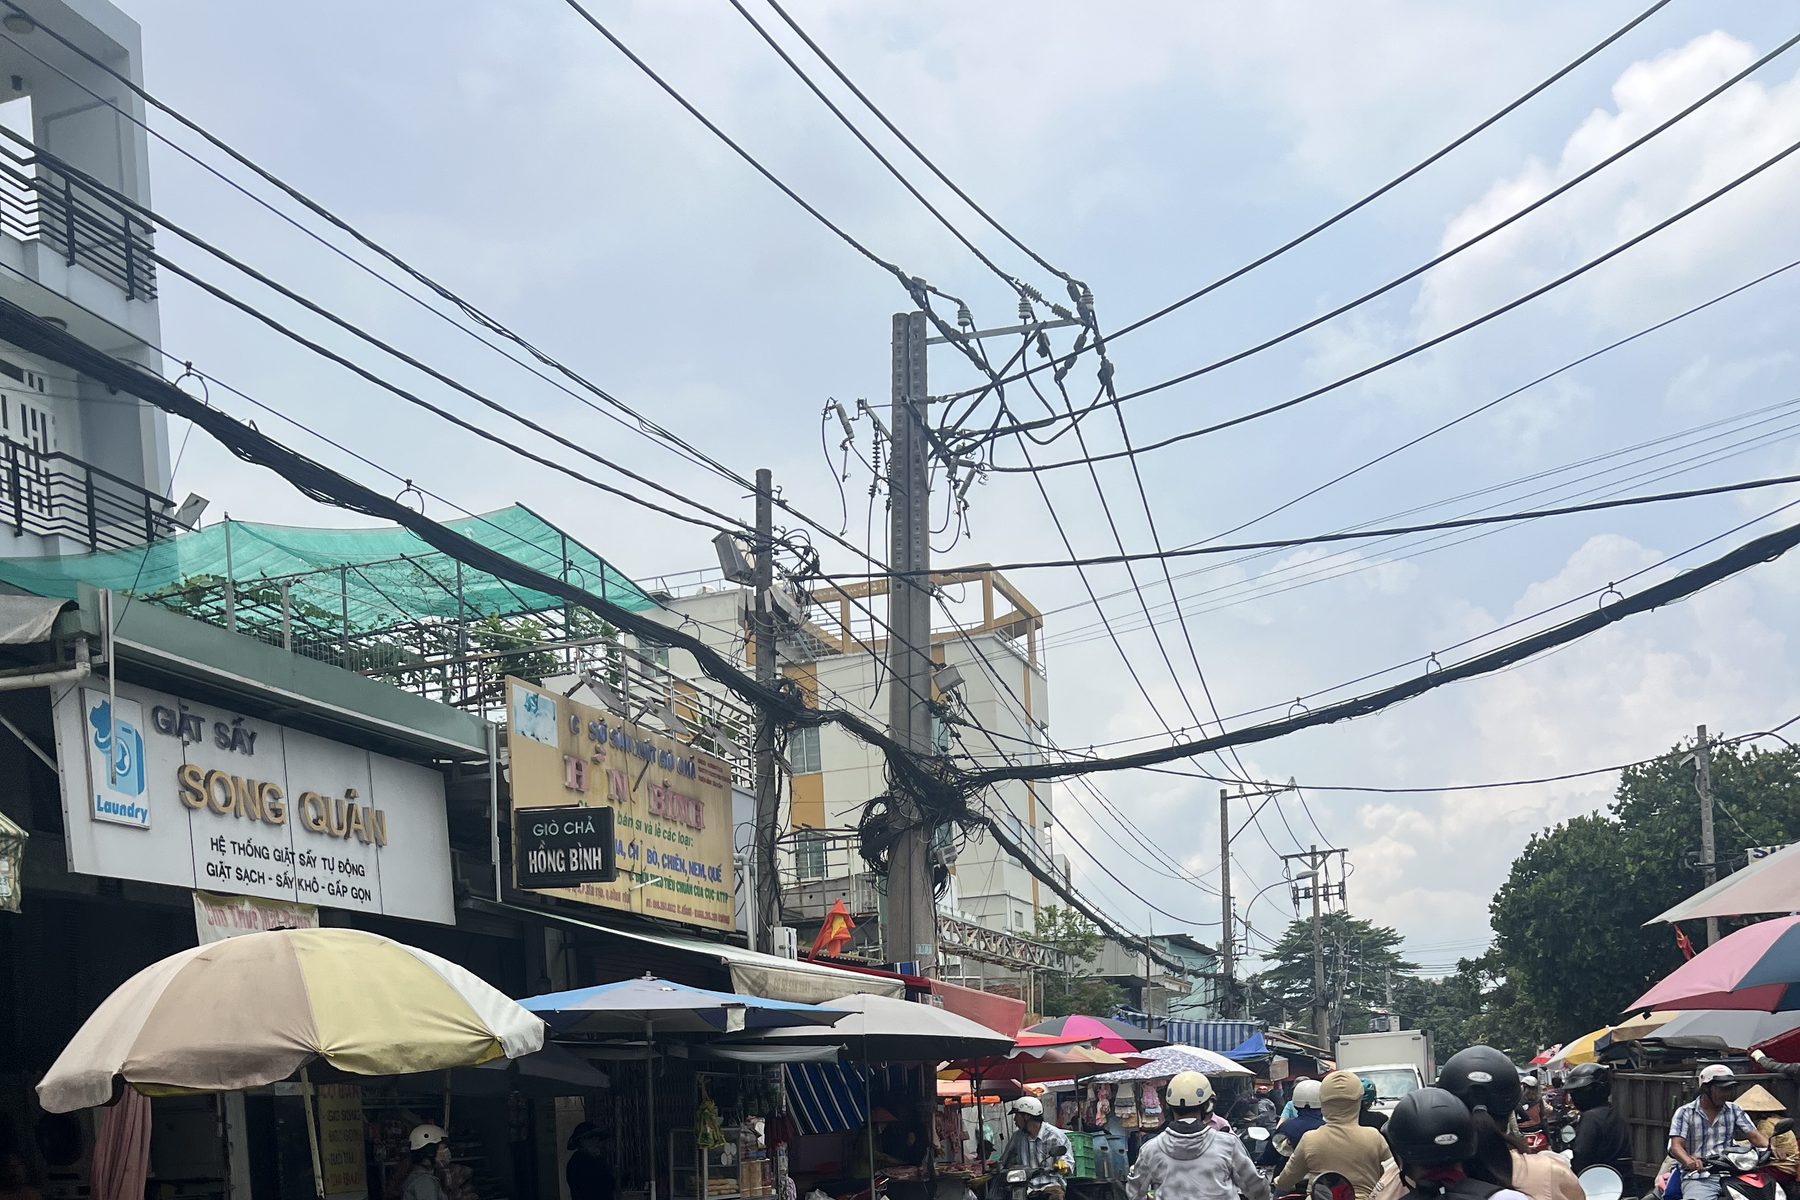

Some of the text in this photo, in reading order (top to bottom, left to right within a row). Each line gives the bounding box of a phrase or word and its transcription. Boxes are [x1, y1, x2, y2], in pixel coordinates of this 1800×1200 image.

[96, 795, 148, 823] Laundry
[177, 763, 287, 826] SONG
[533, 815, 595, 836] GIÒ CHẢ
[617, 810, 633, 828] bán
[644, 822, 653, 835] và
[662, 827, 677, 843] các
[210, 835, 226, 853] HỆ
[230, 838, 270, 860] THỐNG
[273, 847, 295, 867] GIẶT
[299, 850, 318, 868] SẤY
[338, 859, 365, 877] ĐỘNG
[528, 840, 602, 873] HỒNG BÌNH
[206, 861, 232, 883] GIẶT
[236, 868, 265, 886] SẠCH
[276, 871, 296, 889] SẤY
[298, 877, 320, 893] KHÔ
[327, 880, 348, 897] GẤP
[351, 887, 371, 904] GỌN
